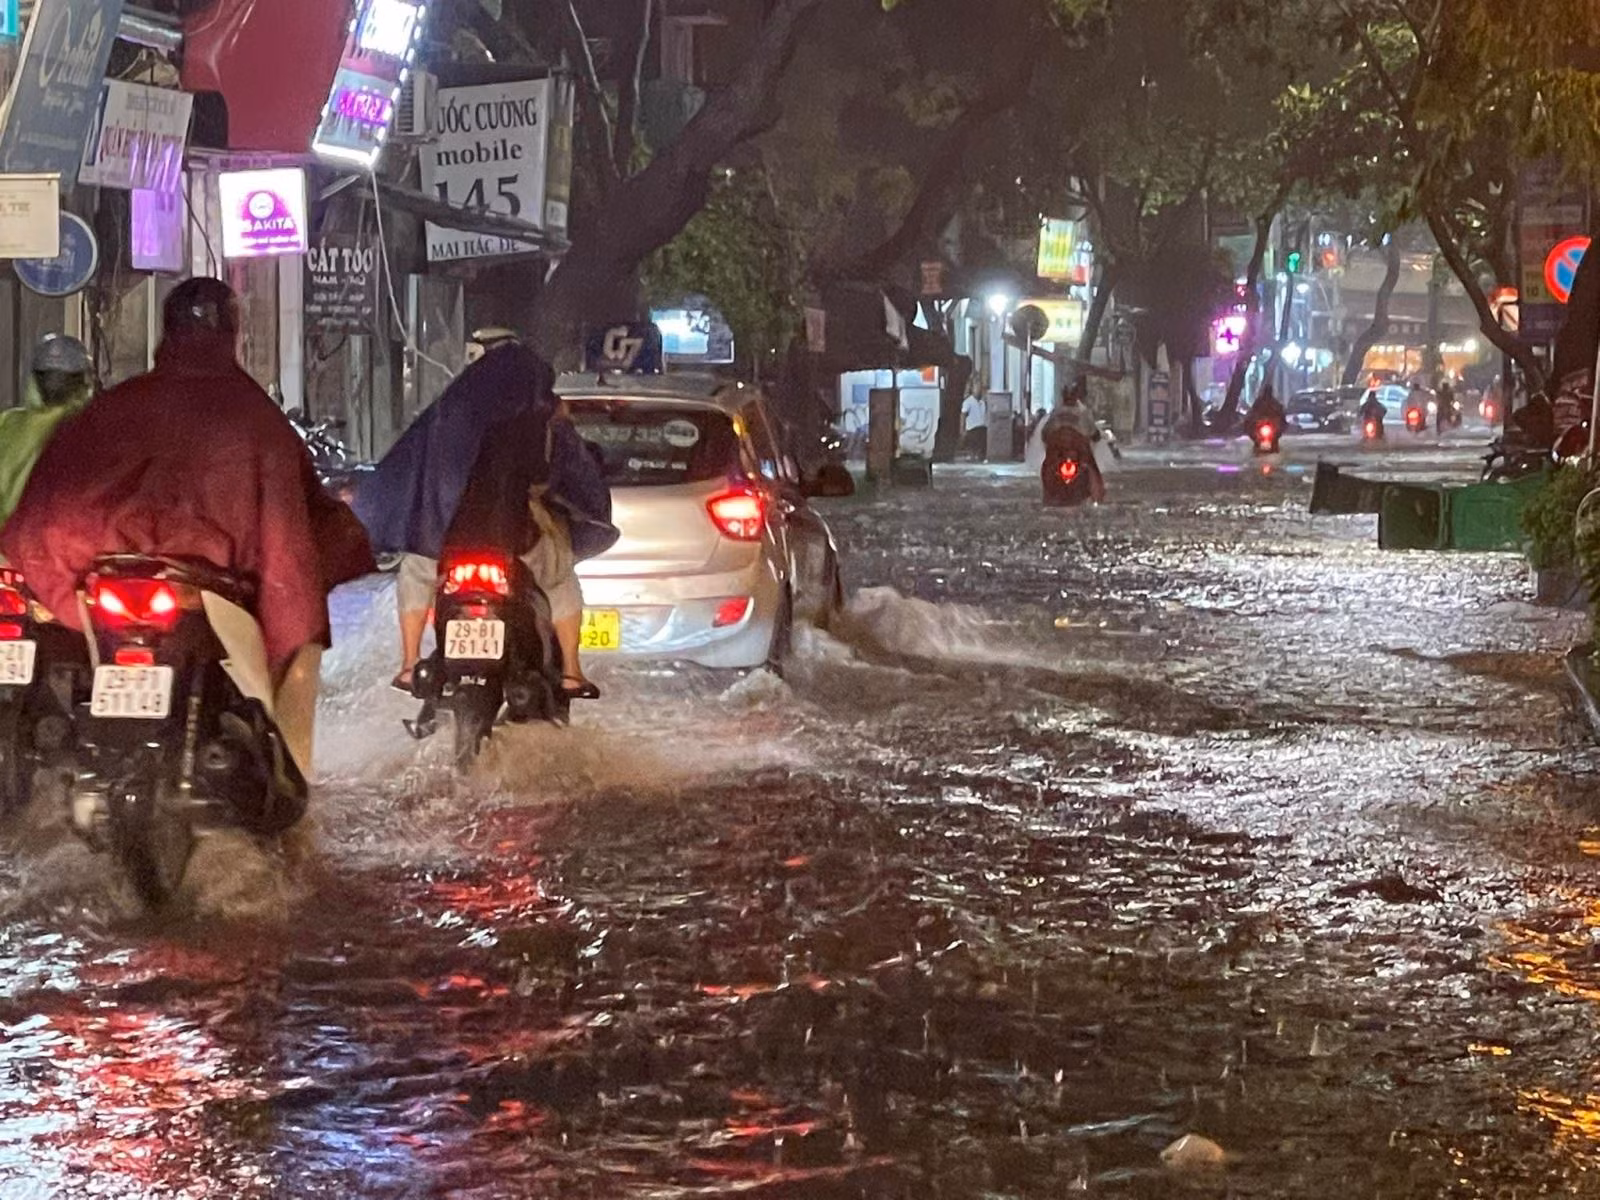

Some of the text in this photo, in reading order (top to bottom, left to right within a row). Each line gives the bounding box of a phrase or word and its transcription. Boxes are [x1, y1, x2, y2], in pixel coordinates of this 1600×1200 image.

[437, 139, 522, 166] mobile
[434, 173, 519, 217] 145
[432, 241, 458, 259] MAI
